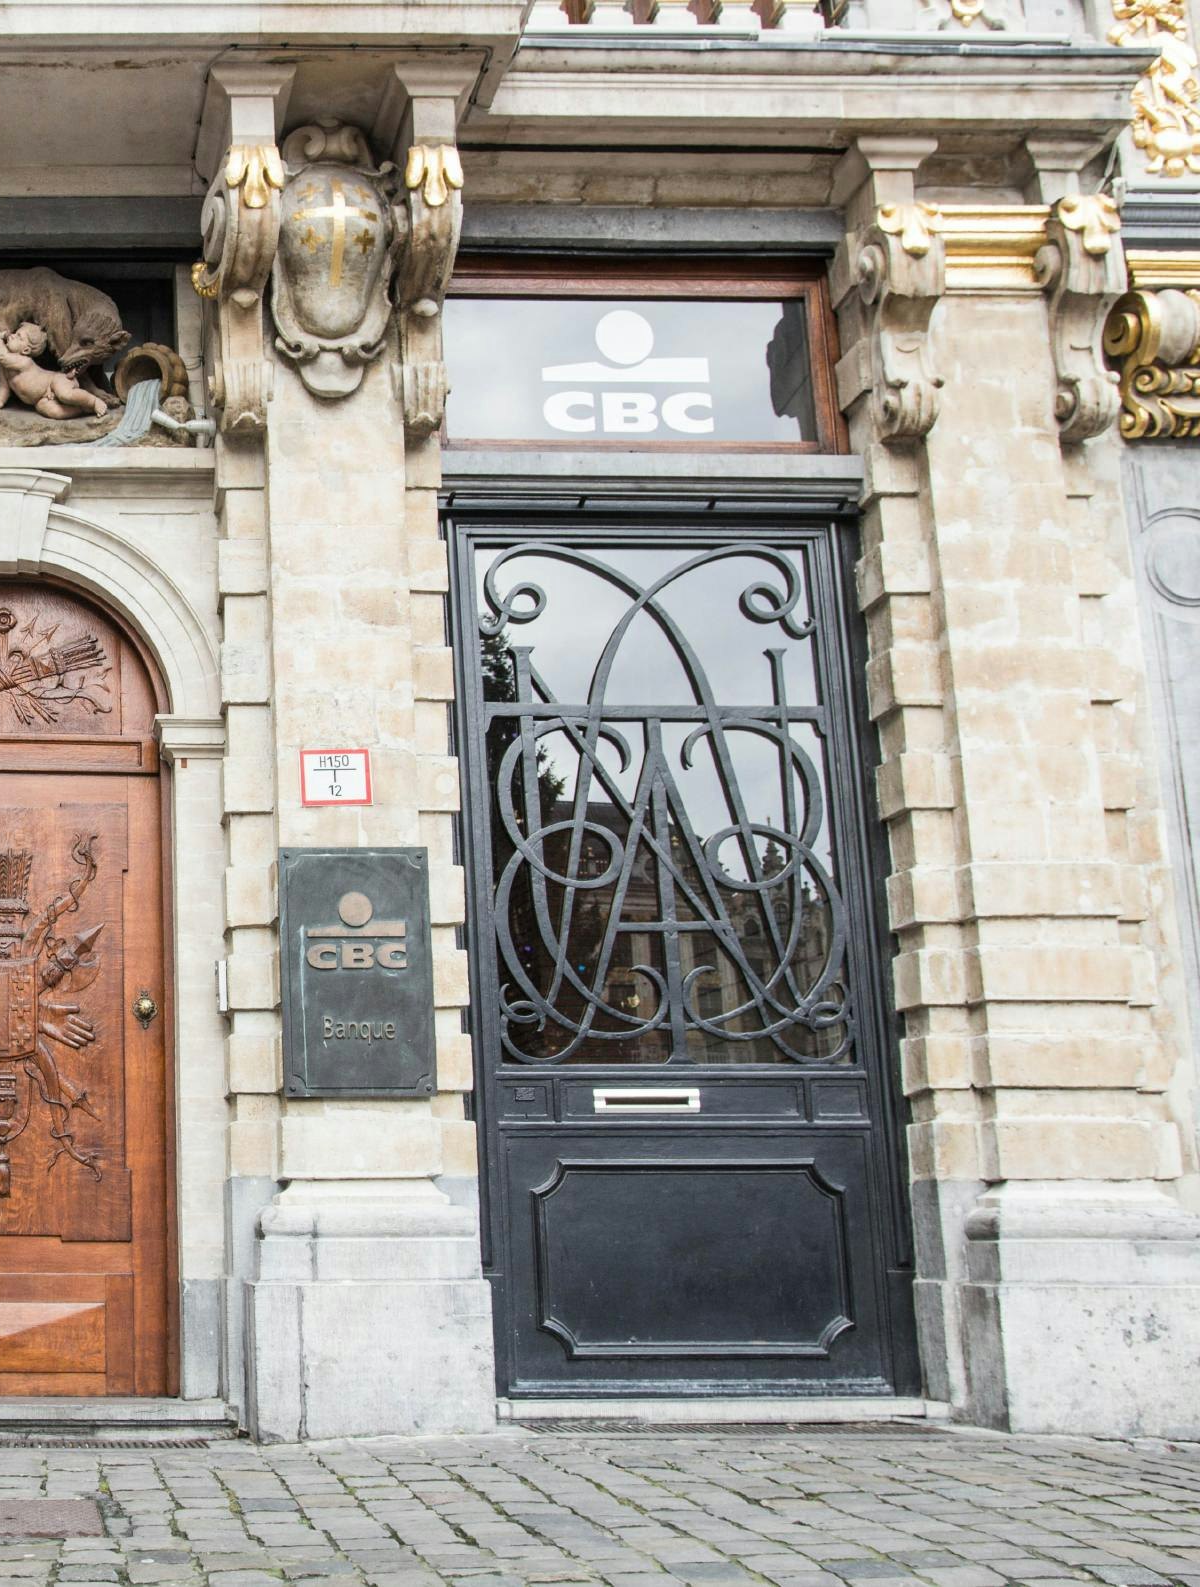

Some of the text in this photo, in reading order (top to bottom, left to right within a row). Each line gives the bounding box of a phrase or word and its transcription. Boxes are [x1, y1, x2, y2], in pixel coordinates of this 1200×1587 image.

[543, 391, 714, 433] CBC
[319, 754, 349, 768] H150
[328, 785, 342, 797] 12
[306, 943, 408, 969] CBC
[322, 1015, 396, 1045] Banque
